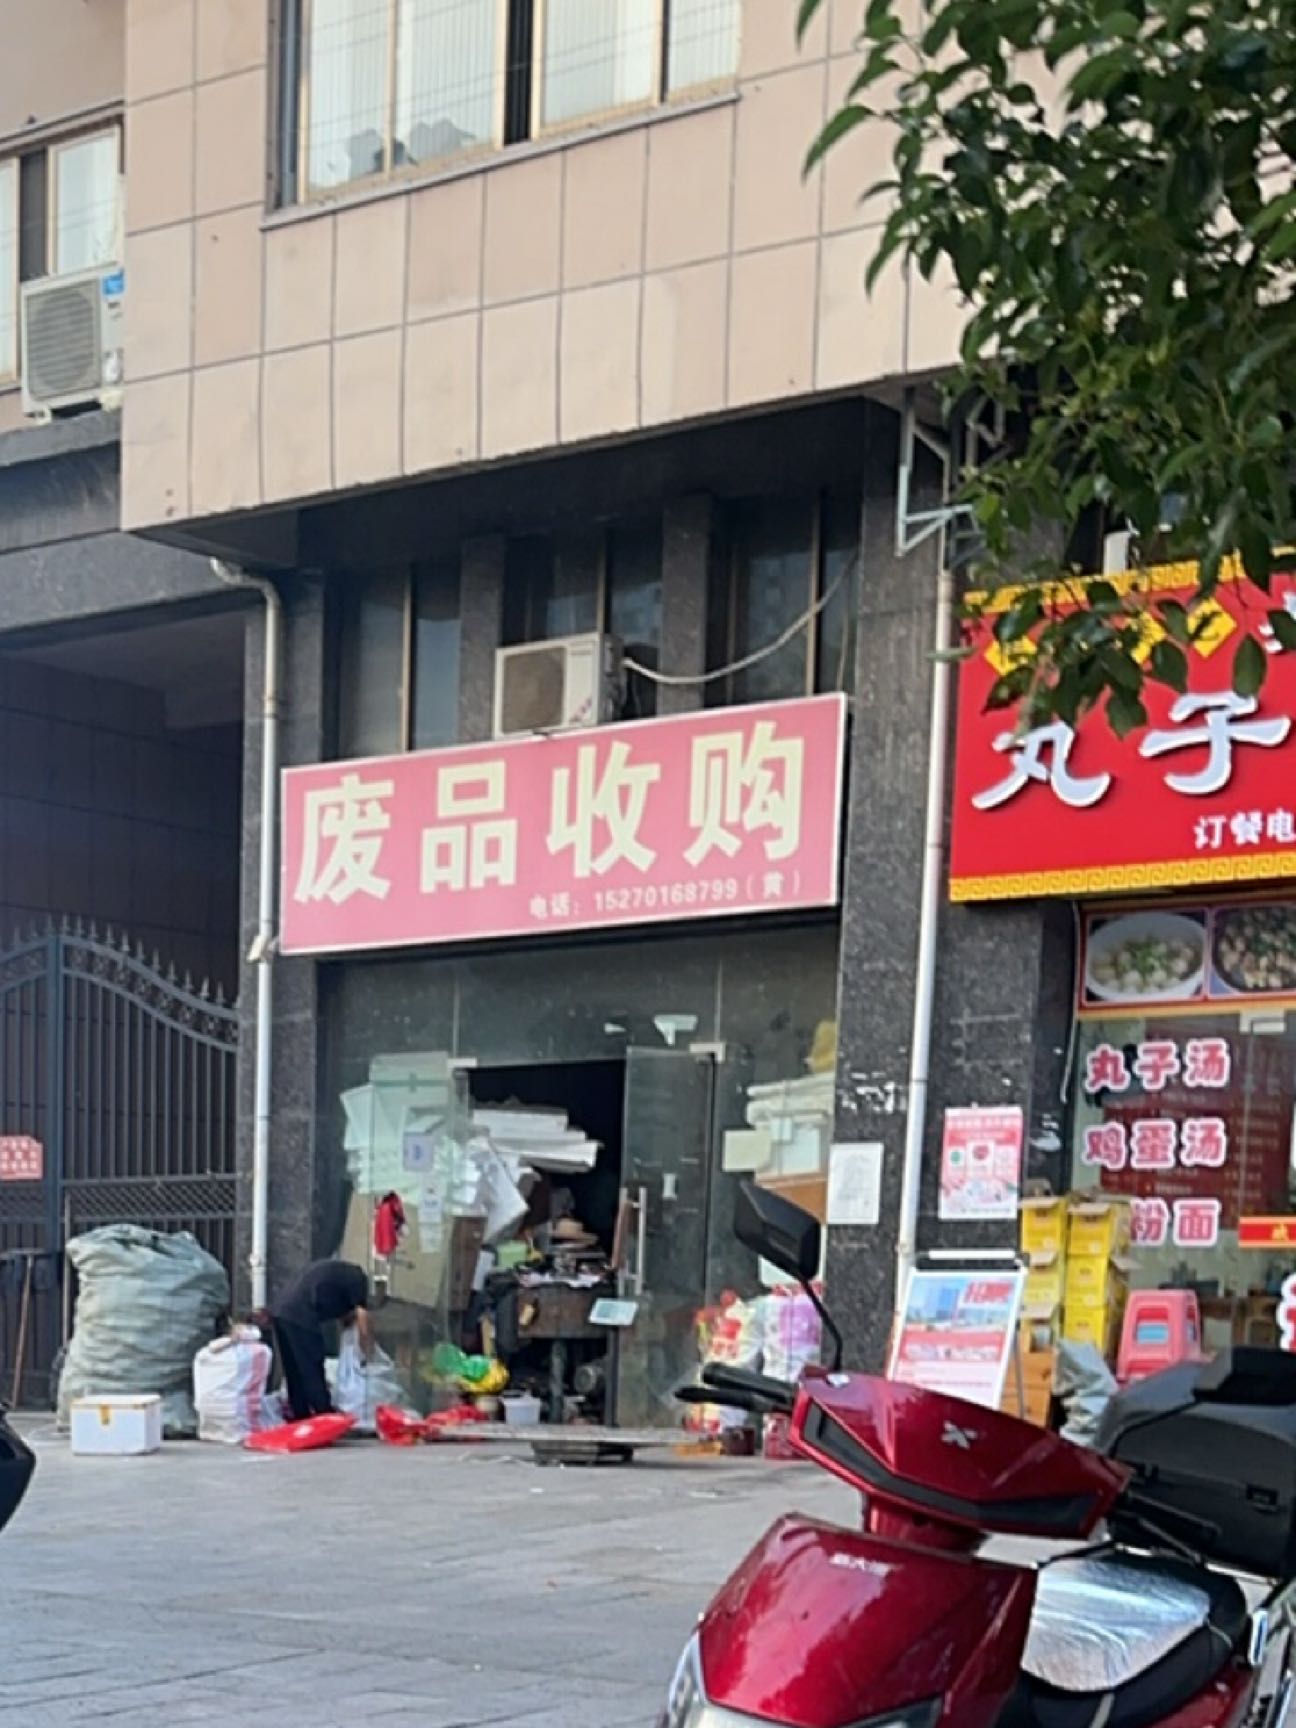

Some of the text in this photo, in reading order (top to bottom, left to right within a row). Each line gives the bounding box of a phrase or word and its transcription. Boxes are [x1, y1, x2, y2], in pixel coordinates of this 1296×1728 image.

[972, 690, 1292, 810] 丸子
[294, 720, 805, 905] 废品收购
[1086, 1039, 1230, 1092] 丸子汤
[1083, 1118, 1227, 1169] 鸡蛋汤
[1131, 1197, 1222, 1246] 粉面
